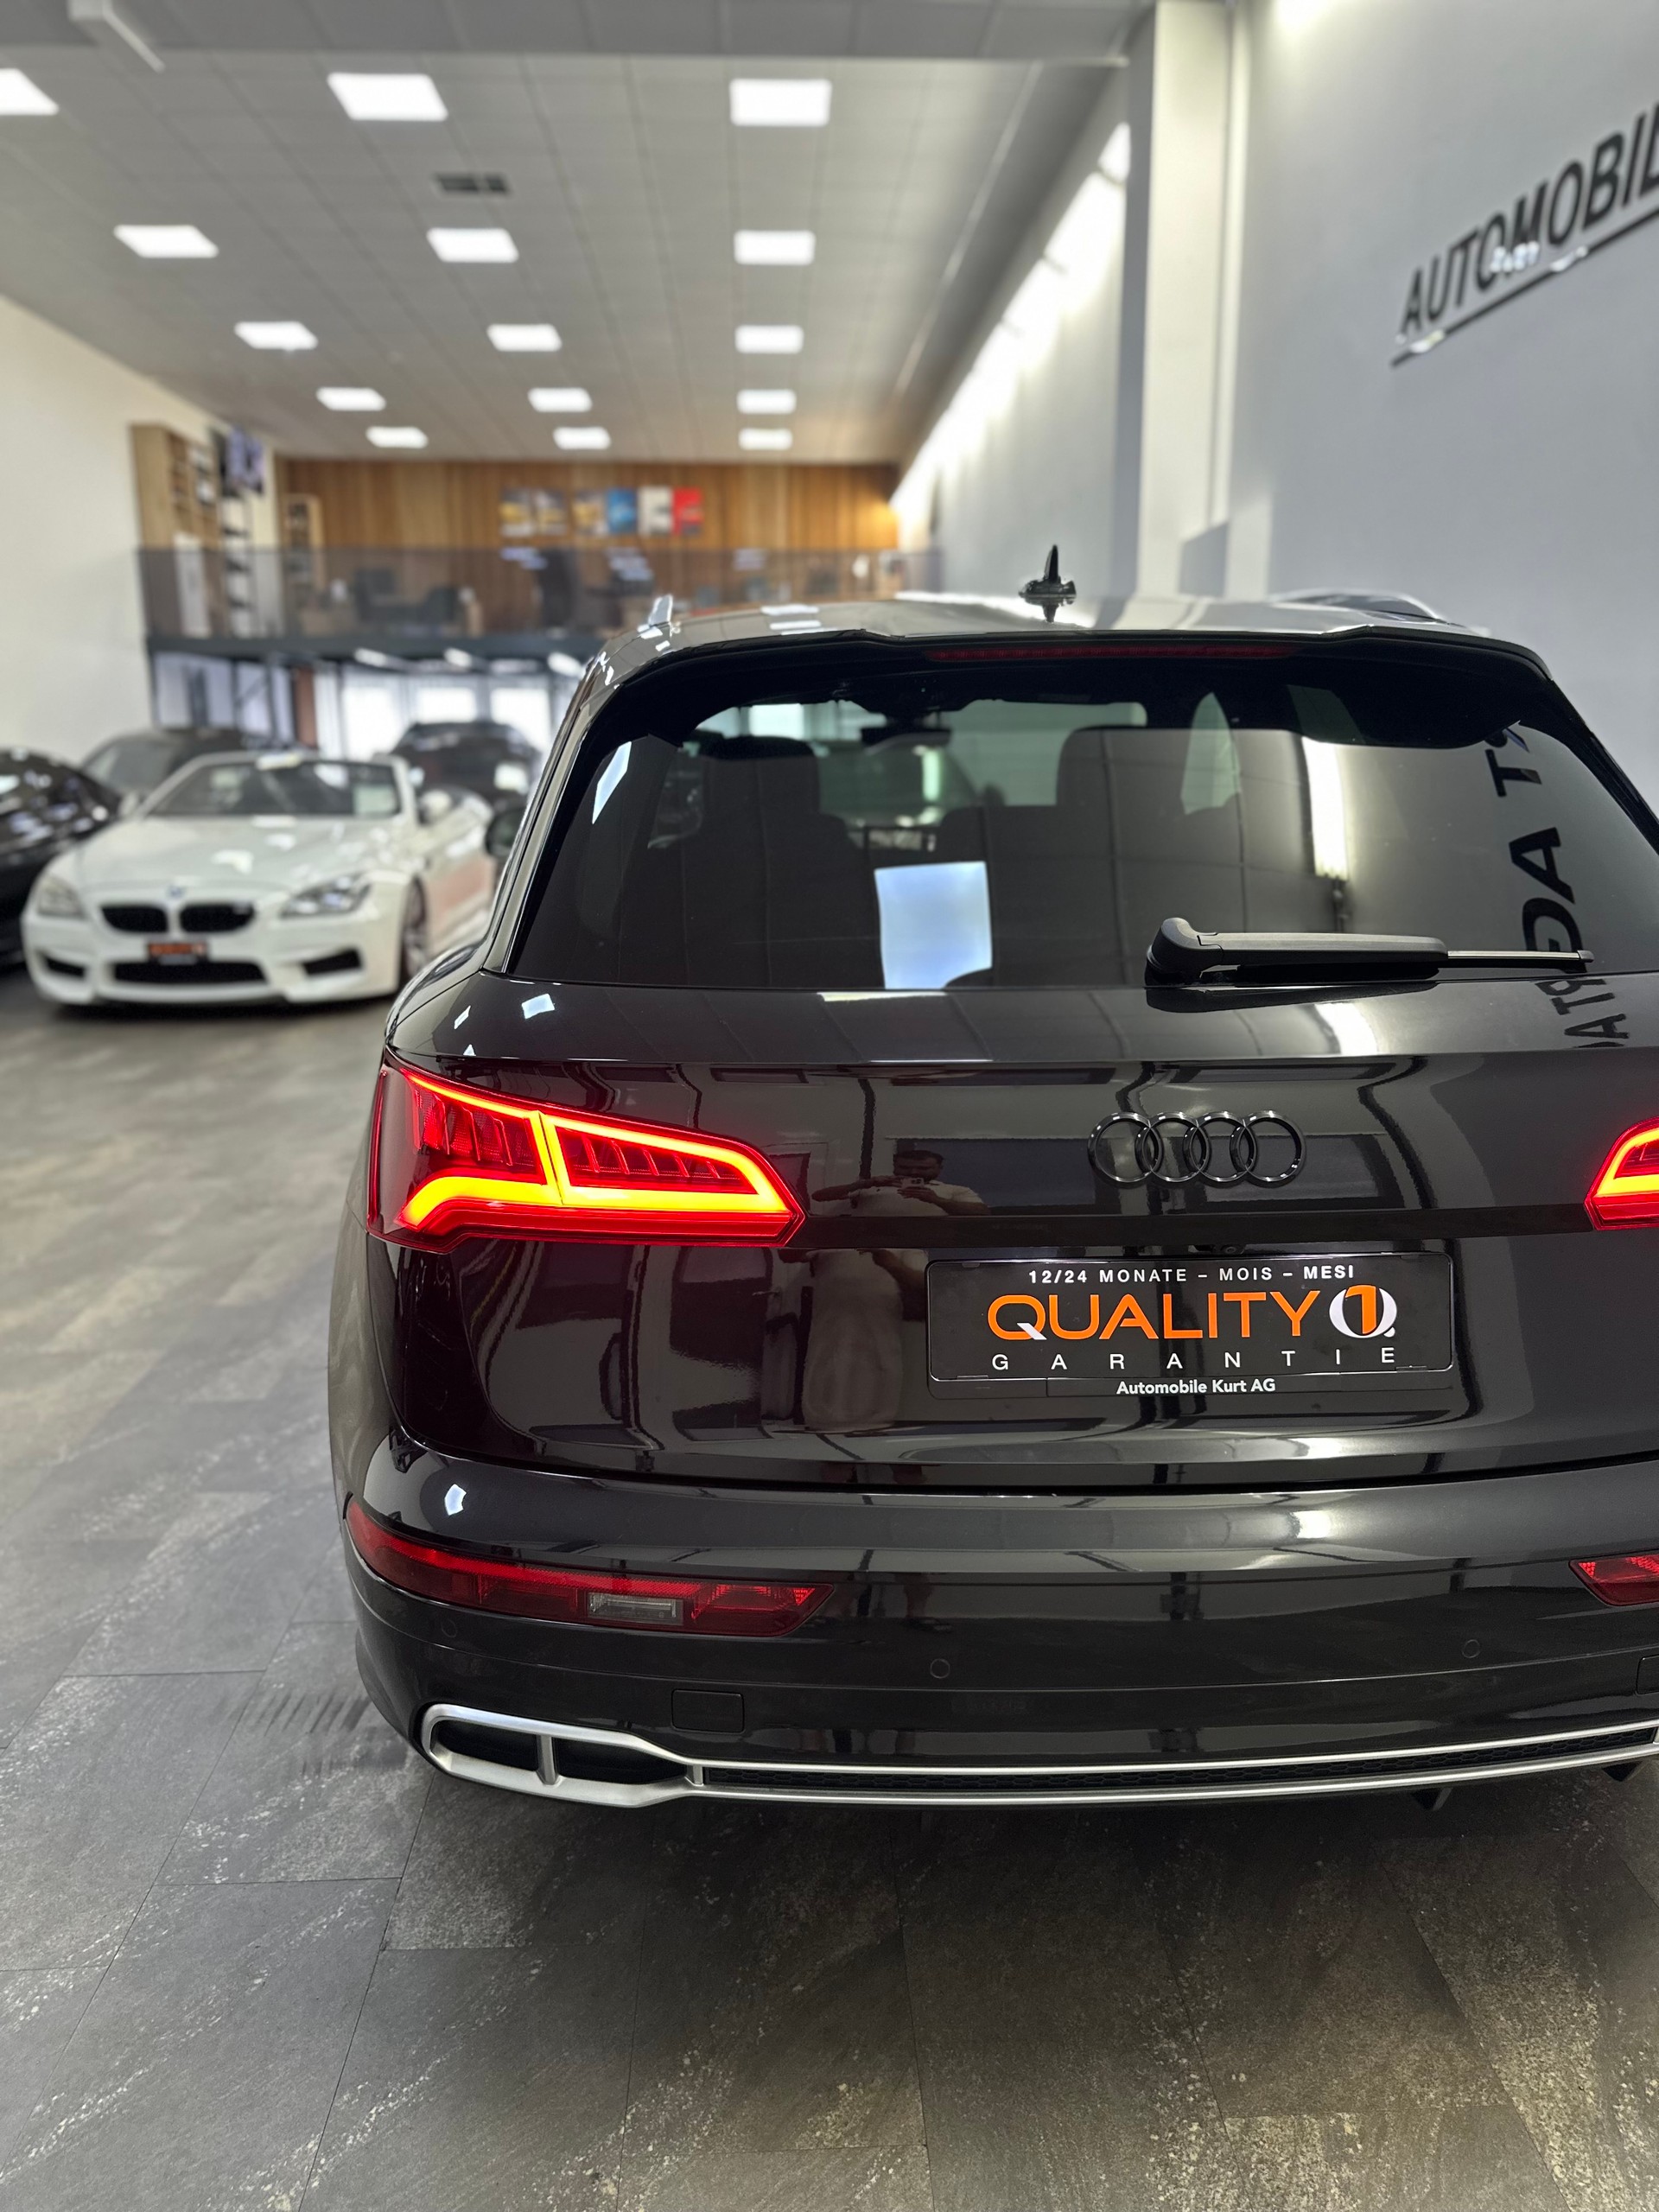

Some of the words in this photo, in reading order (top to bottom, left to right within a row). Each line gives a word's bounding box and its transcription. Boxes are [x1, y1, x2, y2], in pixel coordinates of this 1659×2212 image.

[1028, 1269, 1088, 1284] 12/24
[1099, 1268, 1187, 1283] MONATE
[1219, 1267, 1273, 1281] MOIS
[1303, 1264, 1355, 1280] MESI
[987, 1290, 1321, 1341] QUALITY
[991, 1347, 1395, 1370] GARANTIE
[1116, 1379, 1208, 1395] Automobile
[1211, 1379, 1248, 1394] Kurt
[1250, 1377, 1276, 1392] AG
